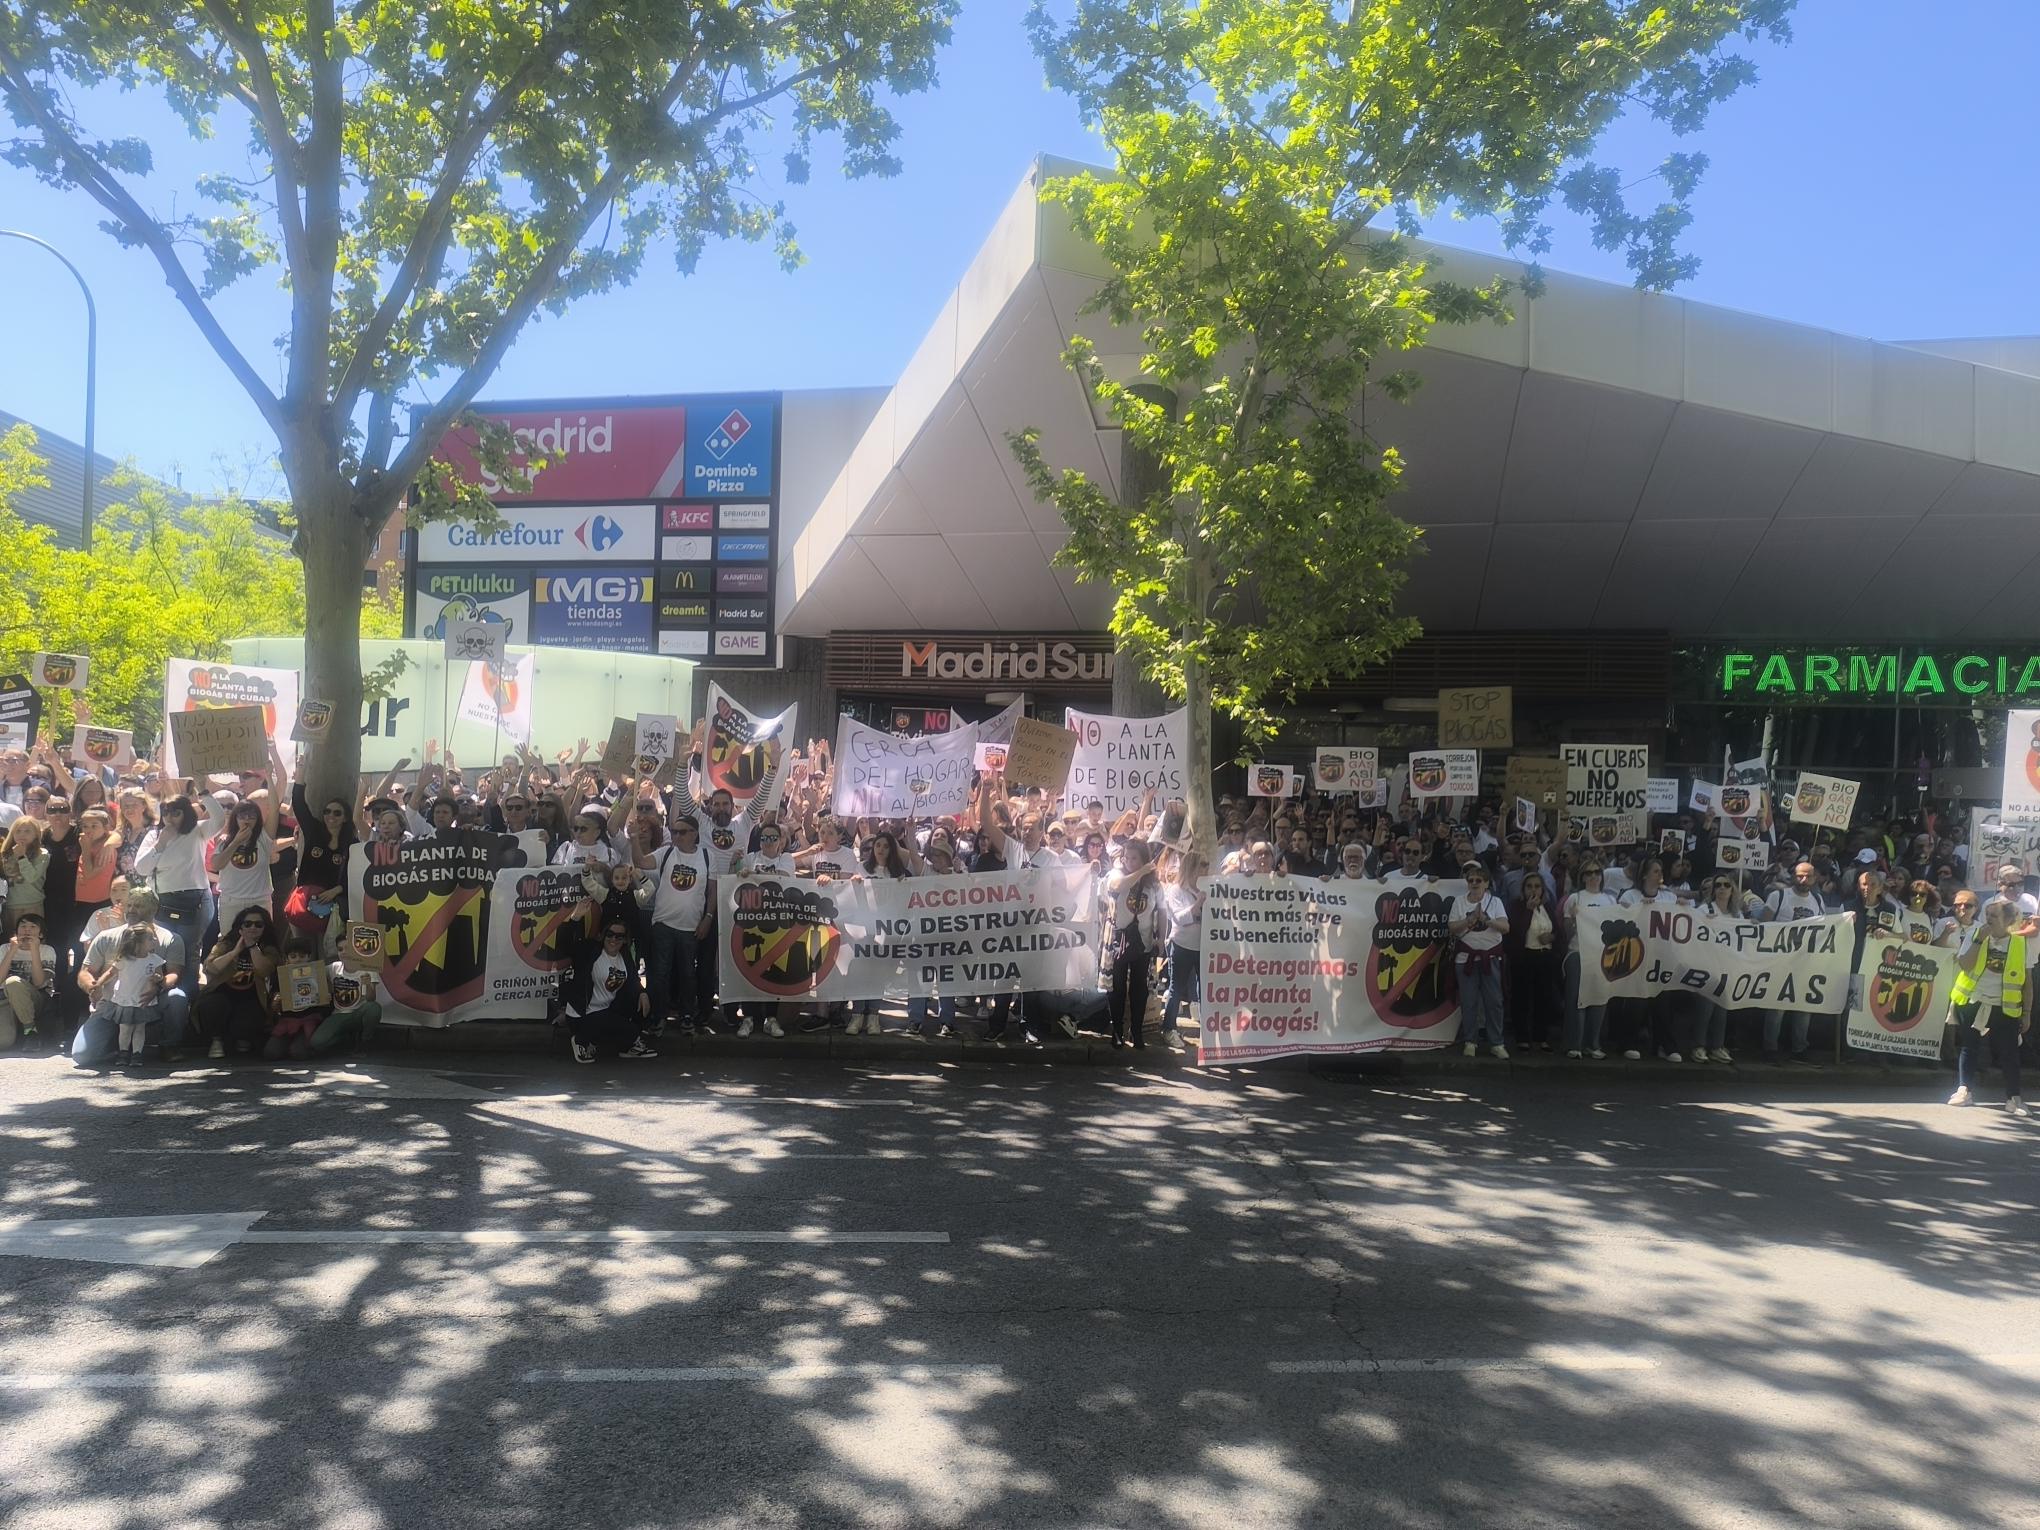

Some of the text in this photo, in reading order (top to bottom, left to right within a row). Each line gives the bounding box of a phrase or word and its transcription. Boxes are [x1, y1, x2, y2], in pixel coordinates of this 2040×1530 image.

[695, 463, 757, 477] Domino's
[708, 479, 744, 492] Pizza
[681, 512, 710, 524] KFC
[567, 604, 622, 619] tiendas
[719, 608, 764, 618] Madrid Sur
[720, 636, 759, 649] GAME
[902, 642, 1114, 680] Madrid Sur
[192, 671, 212, 688] NO
[211, 682, 258, 693] PLANTA DE
[225, 692, 238, 700] EN
[240, 694, 271, 703] CUBAS
[1450, 691, 1501, 711] STOP
[925, 711, 948, 730] NO
[1069, 717, 1167, 748] NO A LA
[851, 730, 936, 763] CERCA
[1107, 742, 1176, 760] PLANTA
[1350, 751, 1375, 760] BIO
[1565, 749, 1647, 769] EN CUBAS
[853, 757, 970, 788] DEL HOGAR
[1075, 765, 1181, 790] DE BIOGÁS
[1587, 769, 1619, 790] NO
[1350, 779, 1374, 788] NO
[1832, 782, 1855, 794] BIO
[891, 798, 909, 812] AL
[1104, 795, 1126, 811] TU
[1566, 789, 1647, 809] QUEREMOS
[2008, 804, 2030, 812] NO A
[1824, 813, 1847, 824] NO
[2019, 815, 2031, 823] DE
[374, 840, 400, 866] NO
[401, 846, 488, 863] PLANTA DE
[373, 866, 496, 887] BIOGÁS EN CUBA
[522, 880, 539, 897] NO
[540, 887, 567, 896] PLANTA
[1210, 884, 1347, 906] ¡Nuestras vidas
[741, 889, 784, 909] NO A LA
[763, 901, 817, 913] PLANTA DE
[737, 912, 831, 924] BIOGÁS EN CUBAS
[1211, 906, 1342, 926] valen más que
[1380, 899, 1420, 923] NO A LA
[1398, 914, 1450, 923] PLANTA D
[875, 906, 1066, 938] NO DESTRUYAS
[1210, 927, 1319, 943] su beneficio!
[1379, 926, 1429, 939] BIOGÁS EN
[1650, 911, 1836, 953] NO a PLANTA
[854, 931, 1086, 960] NUESTRA CALIDAD
[922, 961, 1022, 983] DE VIDA
[1208, 953, 1358, 981] ¡Detengamos
[493, 976, 537, 989] GRIÑÓN
[540, 975, 556, 985] NO
[1646, 960, 1827, 1004] de BIOGAS
[1904, 971, 1933, 981] CUBAS
[494, 989, 550, 1001] CERCA DE
[1207, 983, 1311, 1007] la planta
[1206, 1006, 1319, 1037] de biogás!
[1917, 1039, 1939, 1048] CONTRA
